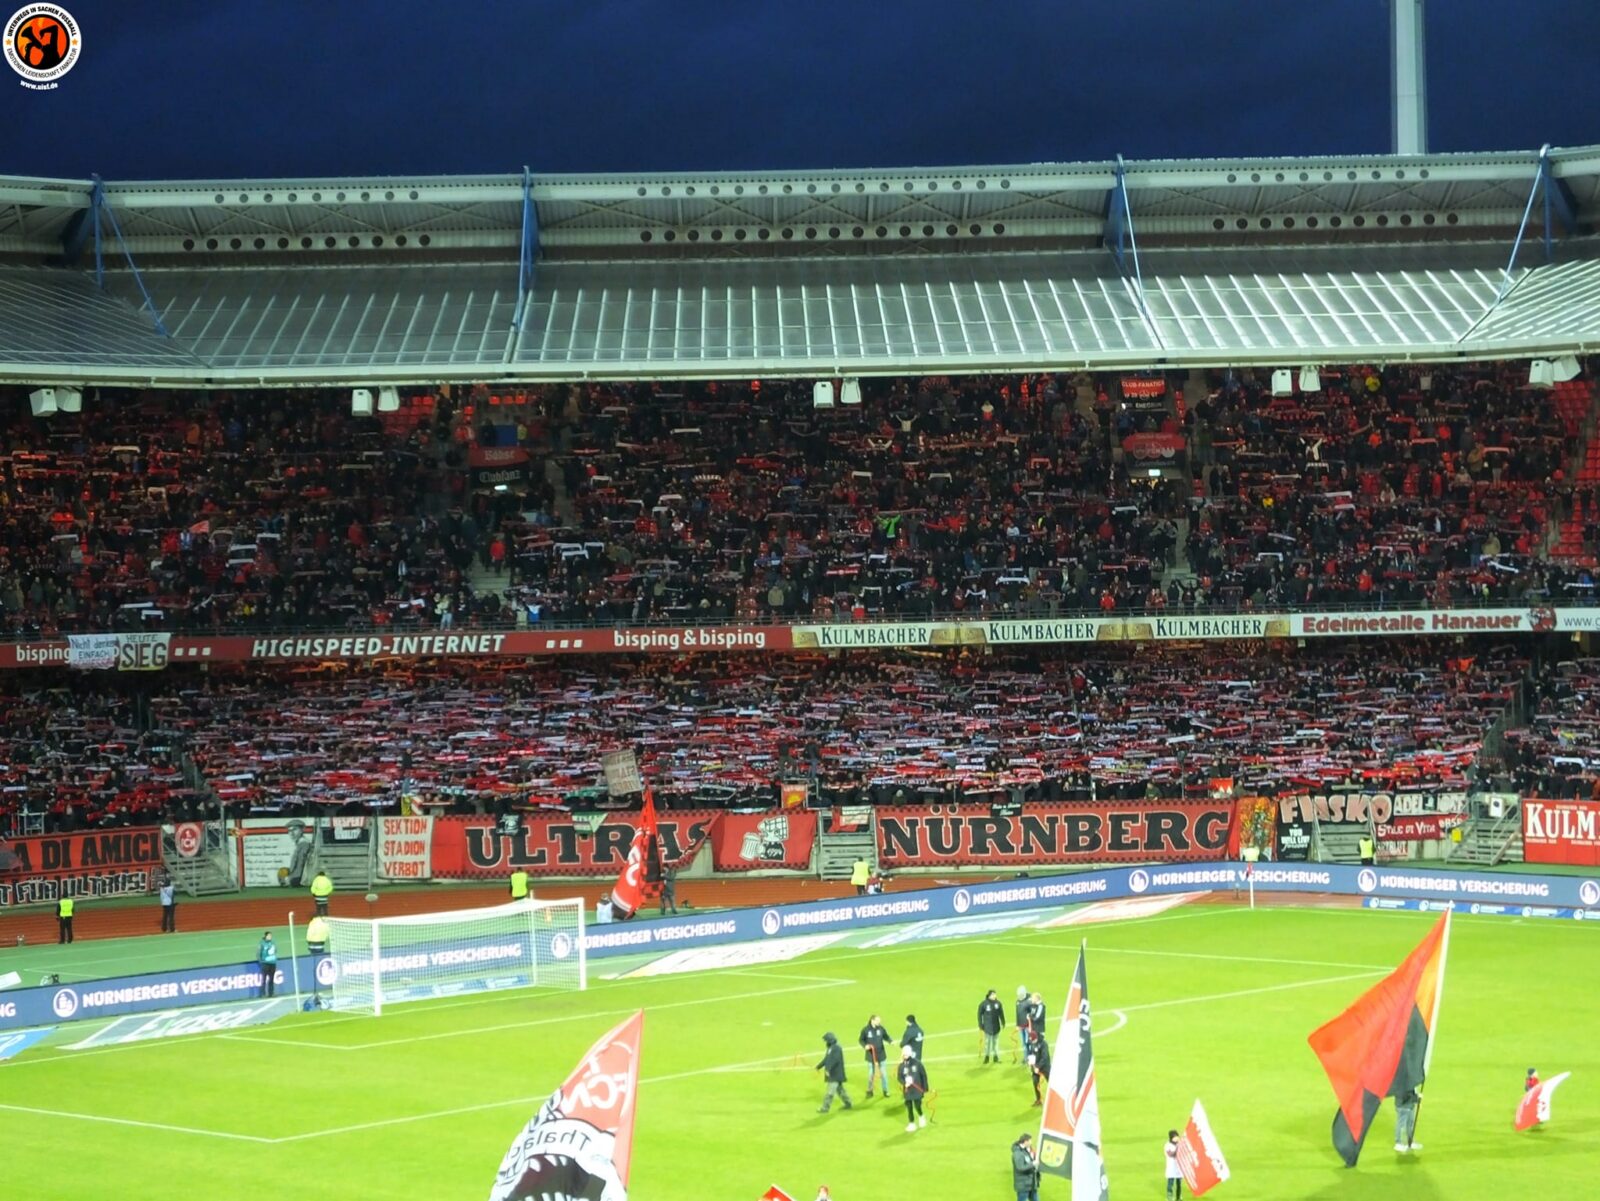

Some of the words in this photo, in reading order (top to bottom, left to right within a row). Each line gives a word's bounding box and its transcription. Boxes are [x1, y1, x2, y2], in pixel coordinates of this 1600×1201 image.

[989, 622, 1095, 642] KULMBACHER
[1156, 618, 1262, 637] KULMBACHER
[1303, 613, 1425, 634] Edelmetalle
[1432, 613, 1522, 631] Hanauer
[251, 634, 506, 658] HIGHSPEED-INTERNET
[613, 630, 680, 650] bisping
[682, 629, 697, 645] &
[699, 629, 766, 648] bisping
[821, 627, 927, 645] KULMBACHER
[16, 645, 71, 664] bisping
[121, 643, 168, 668] SIEG
[383, 818, 427, 835] SEKTION
[1525, 803, 1600, 840] KULM
[879, 806, 1230, 858] NÜRNBERG
[41, 839, 72, 870] DI
[81, 833, 160, 866] AMICI
[383, 840, 425, 856] STADION
[384, 861, 425, 877] VERBOT
[16, 876, 58, 903] FÜR
[1039, 879, 1107, 898] VERSICHERUNG
[1460, 879, 1549, 897] VERSICHERUNG
[855, 899, 930, 919] VERSICHERUNG
[654, 920, 736, 941] VERSICHERUNG
[82, 982, 179, 1008] NÜRNBERGER
[181, 970, 284, 996] VERSICHERUG
